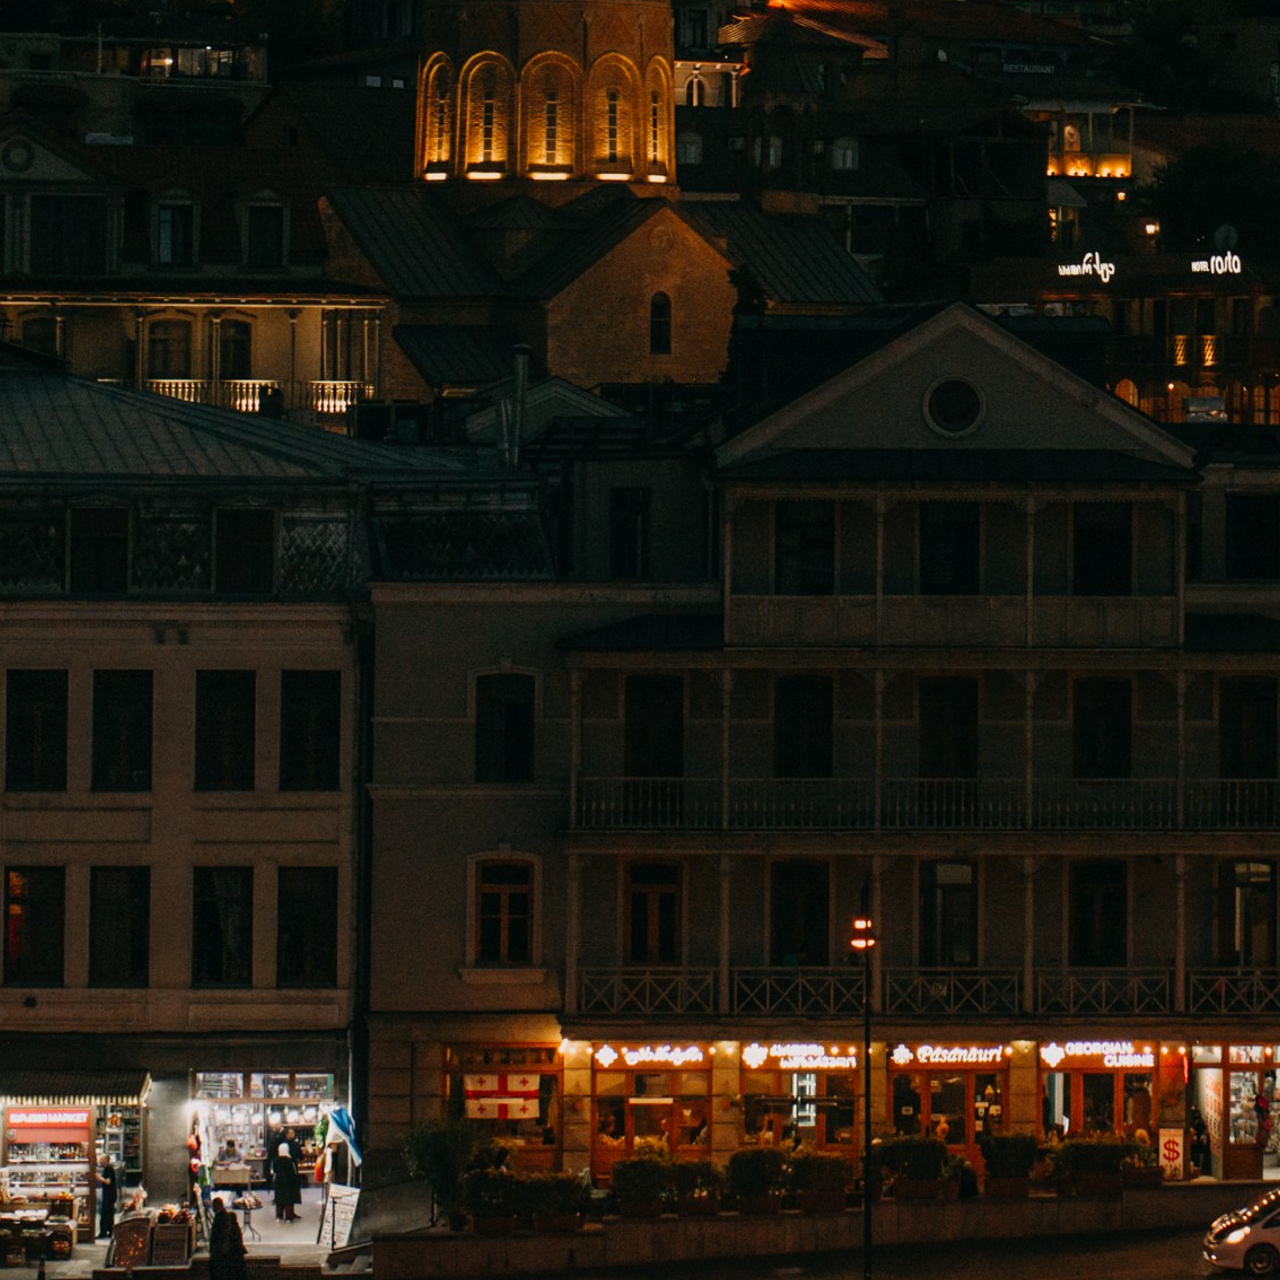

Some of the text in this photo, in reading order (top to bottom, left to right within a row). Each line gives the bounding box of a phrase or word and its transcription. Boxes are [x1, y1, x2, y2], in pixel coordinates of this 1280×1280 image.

[1191, 260, 1209, 272] HOTEL
[1065, 1042, 1133, 1055] GEORGIAN
[1103, 1054, 1155, 1067] CUISINE
[48, 1113, 88, 1123] MARKET
